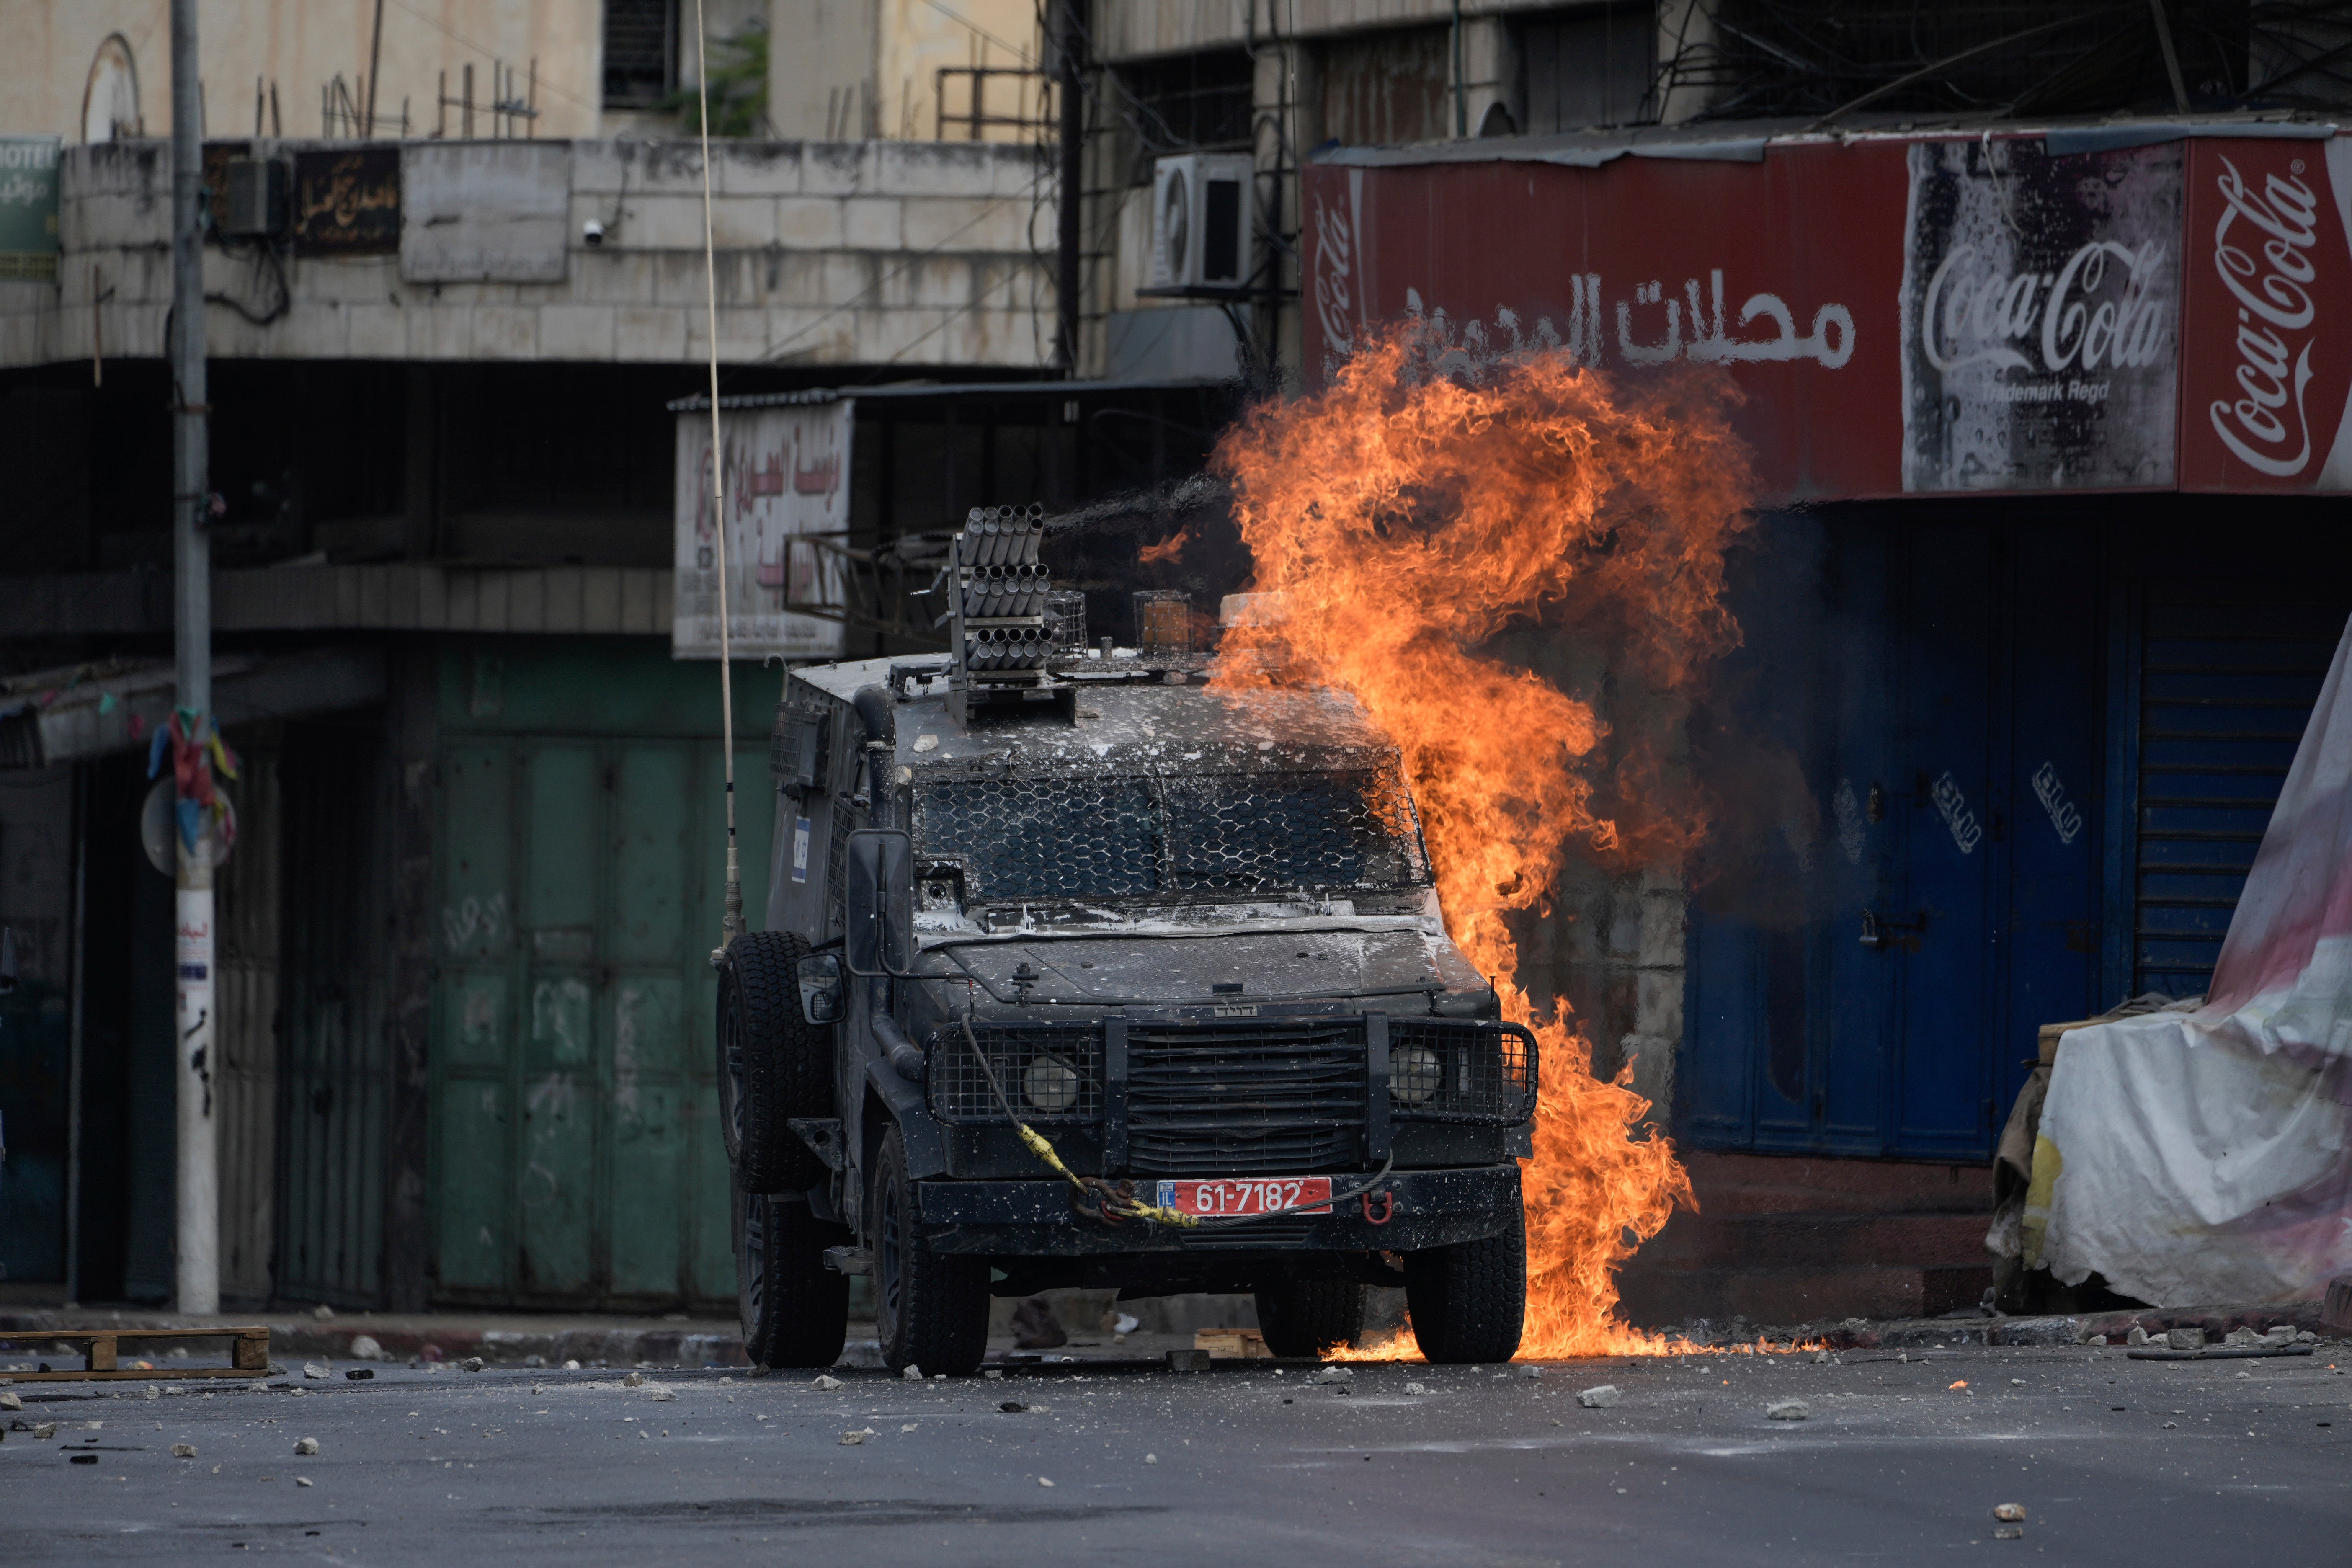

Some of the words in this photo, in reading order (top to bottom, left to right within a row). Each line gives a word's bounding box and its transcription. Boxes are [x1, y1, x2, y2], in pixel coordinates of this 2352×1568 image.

[1615, 268, 1856, 369] محلات
[1923, 240, 2168, 372] Coca-Cola
[2210, 153, 2316, 477] Coca-Cola
[1982, 376, 2063, 402] Trademark
[2068, 379, 2110, 405] Regd
[1217, 1006, 1253, 1016] דויד
[1162, 1192, 1172, 1205] IL
[1196, 1182, 1300, 1212] 61-7182
